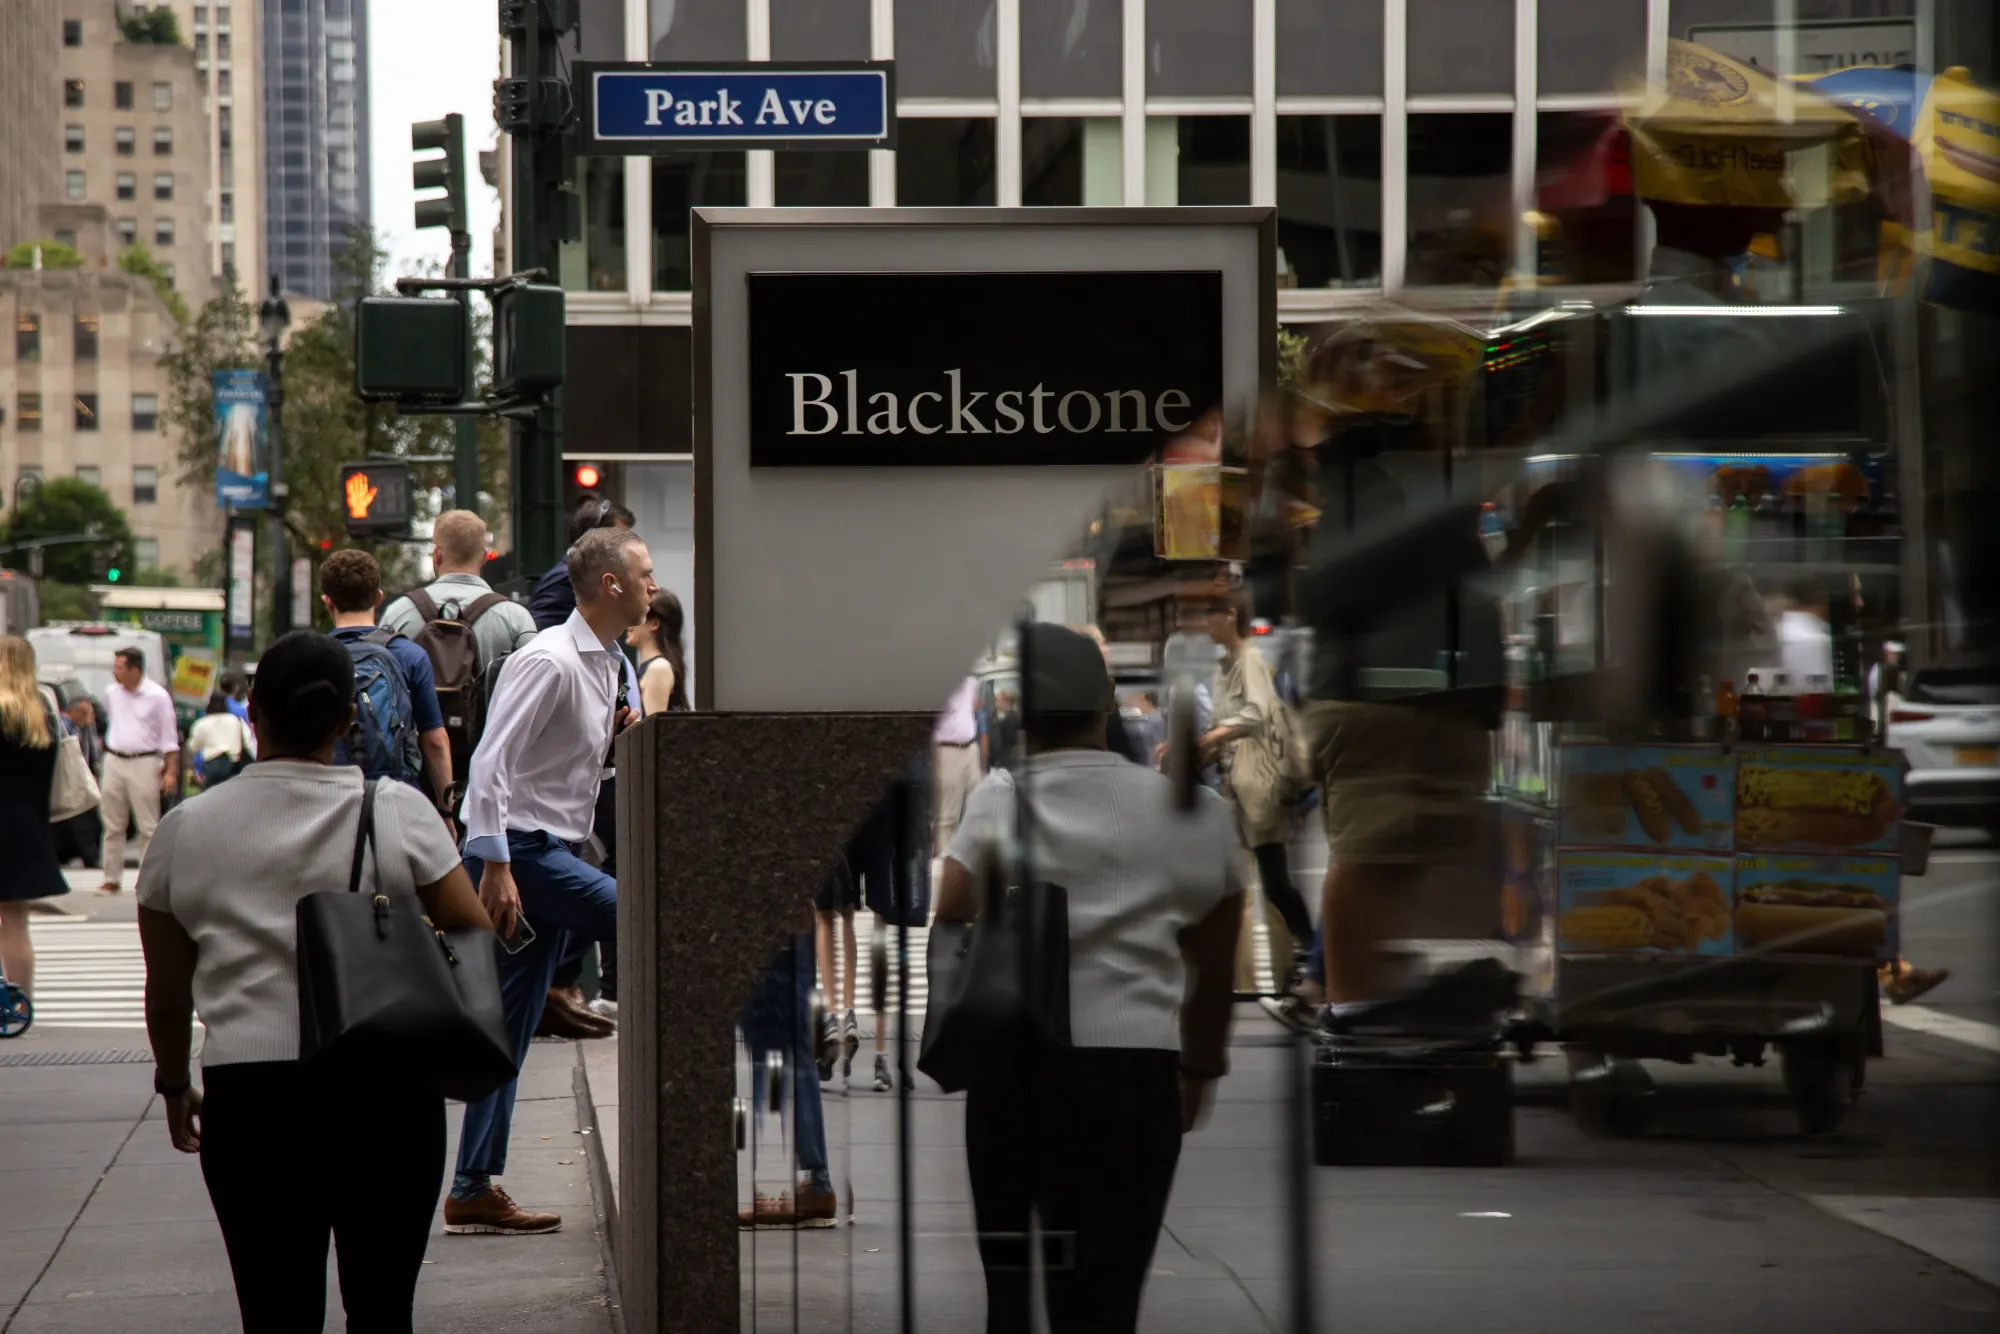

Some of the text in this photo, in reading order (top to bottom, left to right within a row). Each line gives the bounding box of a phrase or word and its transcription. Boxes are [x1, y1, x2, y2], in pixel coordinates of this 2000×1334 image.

[644, 88, 837, 125] Park Ave
[785, 368, 1192, 435] Blackstone
[144, 614, 201, 630] COFFEE
